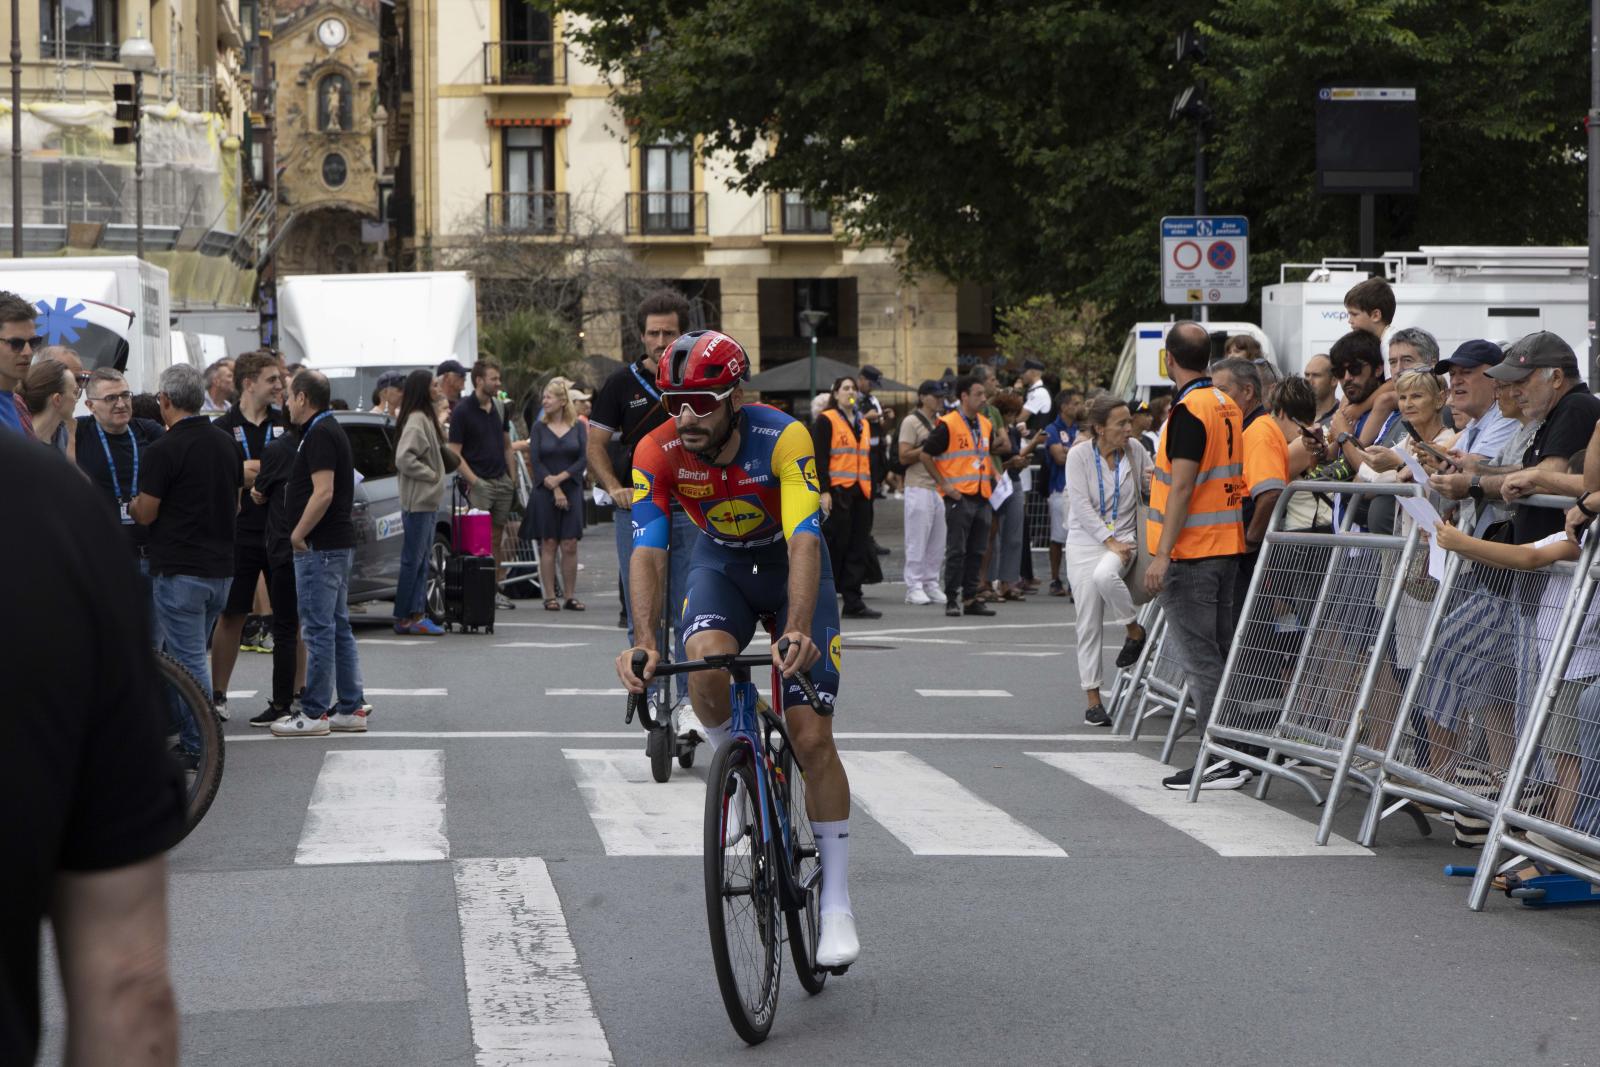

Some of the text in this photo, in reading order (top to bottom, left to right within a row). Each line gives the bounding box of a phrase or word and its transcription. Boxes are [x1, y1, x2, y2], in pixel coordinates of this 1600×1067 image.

[752, 425, 781, 437] TREK
[958, 438, 969, 449] 24
[678, 468, 709, 480] Santini
[695, 614, 727, 623] Santini
[755, 896, 781, 1026] BONTRAGER
